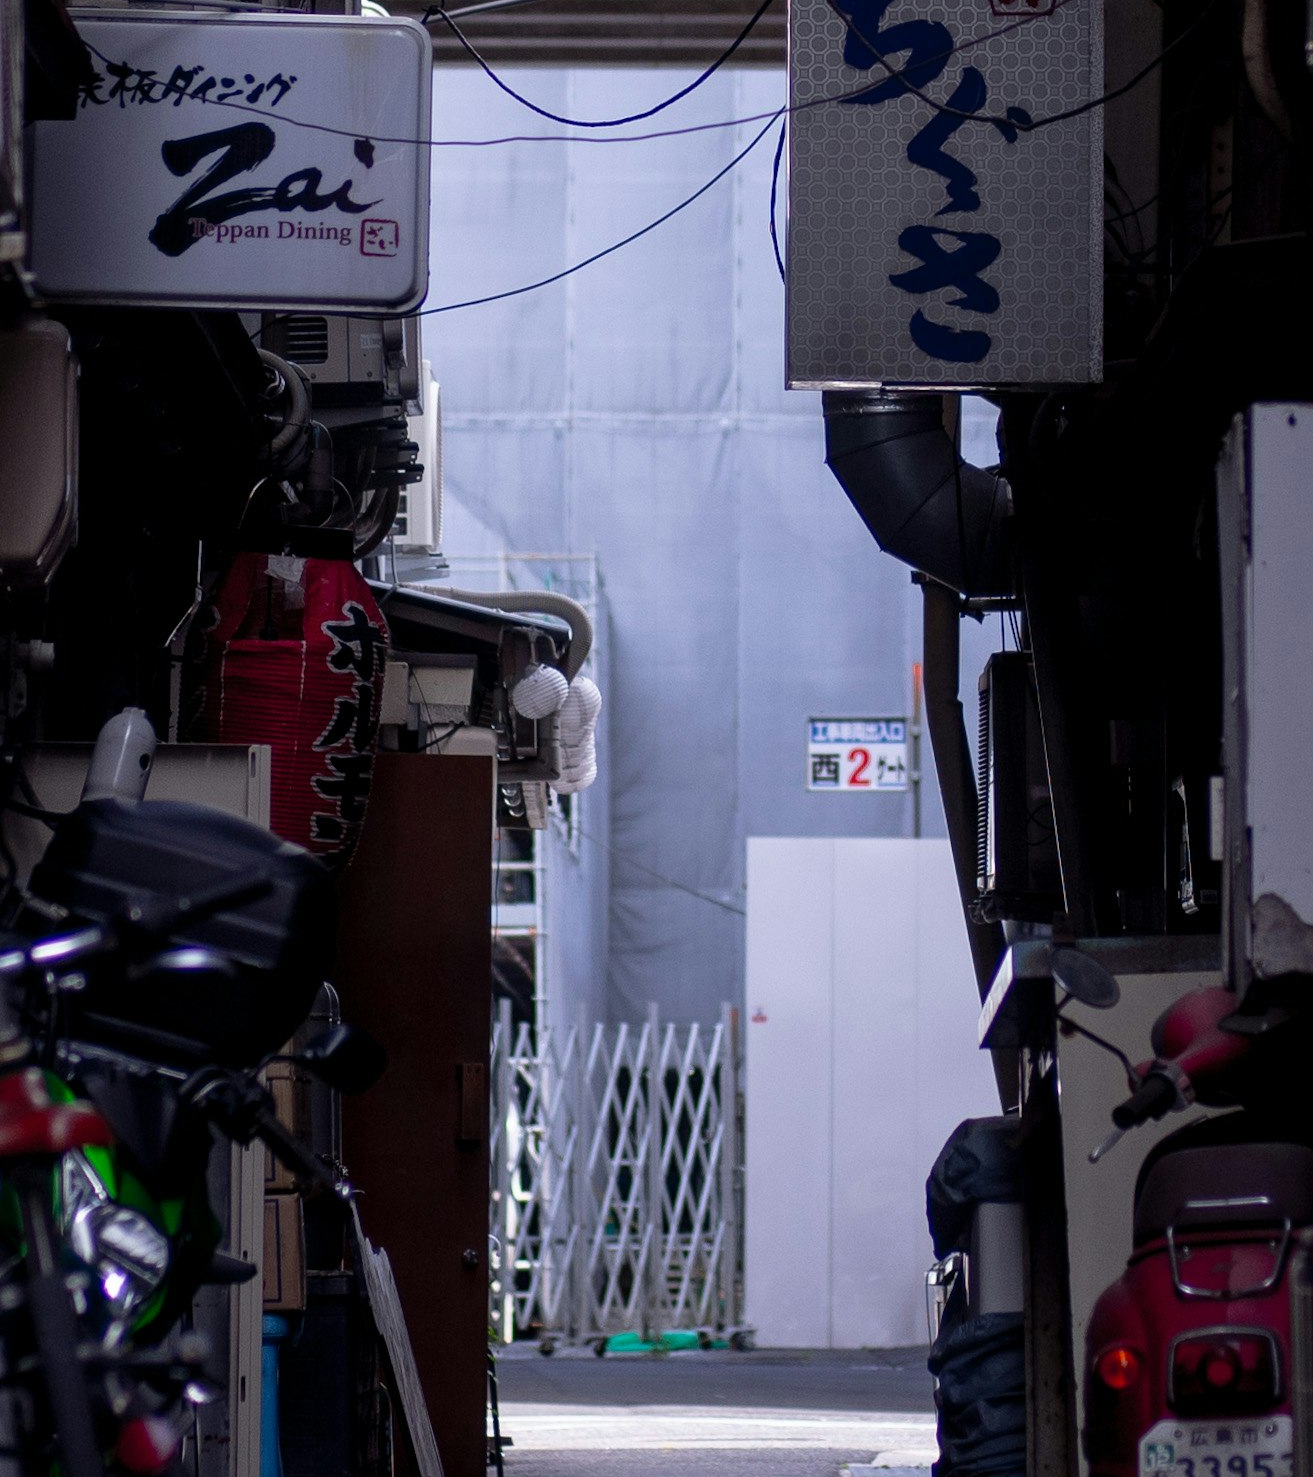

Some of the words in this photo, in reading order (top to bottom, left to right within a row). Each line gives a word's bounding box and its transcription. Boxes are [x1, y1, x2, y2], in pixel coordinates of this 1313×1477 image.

[149, 122, 384, 257] Zai
[189, 218, 269, 245] Teppan
[277, 221, 352, 245] Dining
[811, 753, 841, 784] 西
[848, 748, 871, 786] 2
